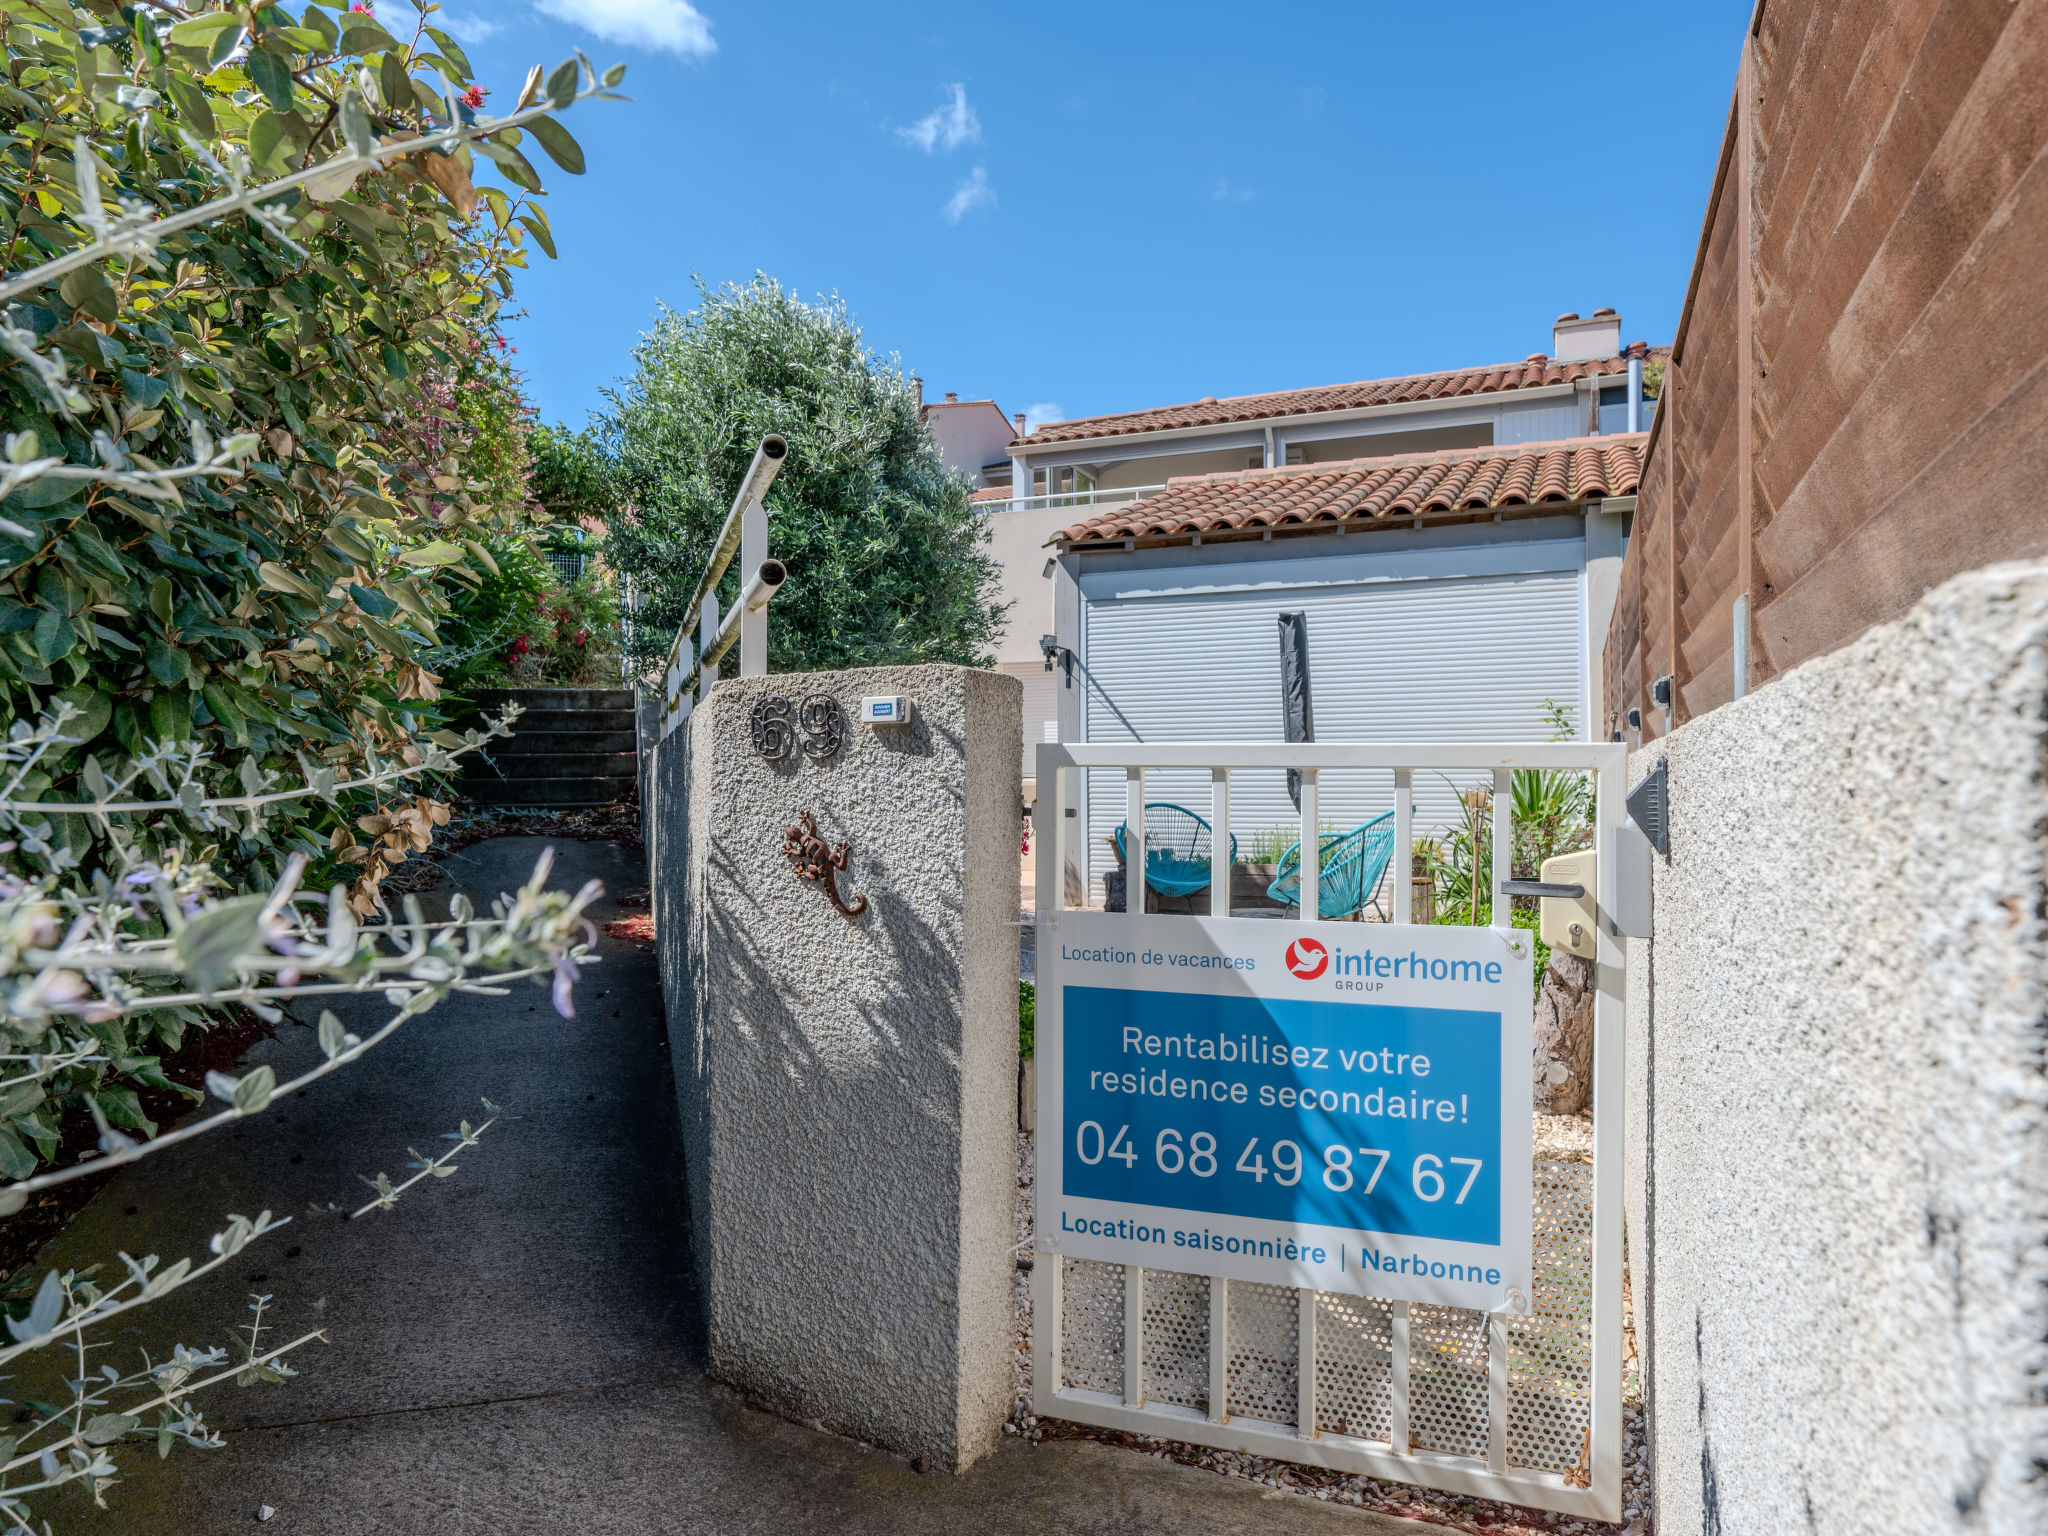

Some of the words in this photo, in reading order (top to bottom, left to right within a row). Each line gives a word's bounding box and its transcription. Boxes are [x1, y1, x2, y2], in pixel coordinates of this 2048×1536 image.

[751, 693, 843, 761] 69
[1062, 944, 1136, 964] Location
[1141, 949, 1163, 965] de
[1168, 953, 1255, 970] vacances
[1335, 947, 1502, 984] interhome
[1335, 980, 1384, 992] GROUP
[1122, 1026, 1329, 1069] Rentabilisez
[1338, 1047, 1431, 1077] votre
[1090, 1067, 1248, 1104] residence
[1259, 1085, 1468, 1124] secondaire!
[1076, 1120, 1138, 1169] 04
[1155, 1128, 1218, 1177] 68
[1235, 1137, 1303, 1187] 49
[1322, 1144, 1390, 1194] 87
[1412, 1153, 1483, 1205] 67
[1062, 1211, 1166, 1244] Location
[1173, 1229, 1326, 1264] saisonnière
[1361, 1247, 1501, 1285] Narbonne
